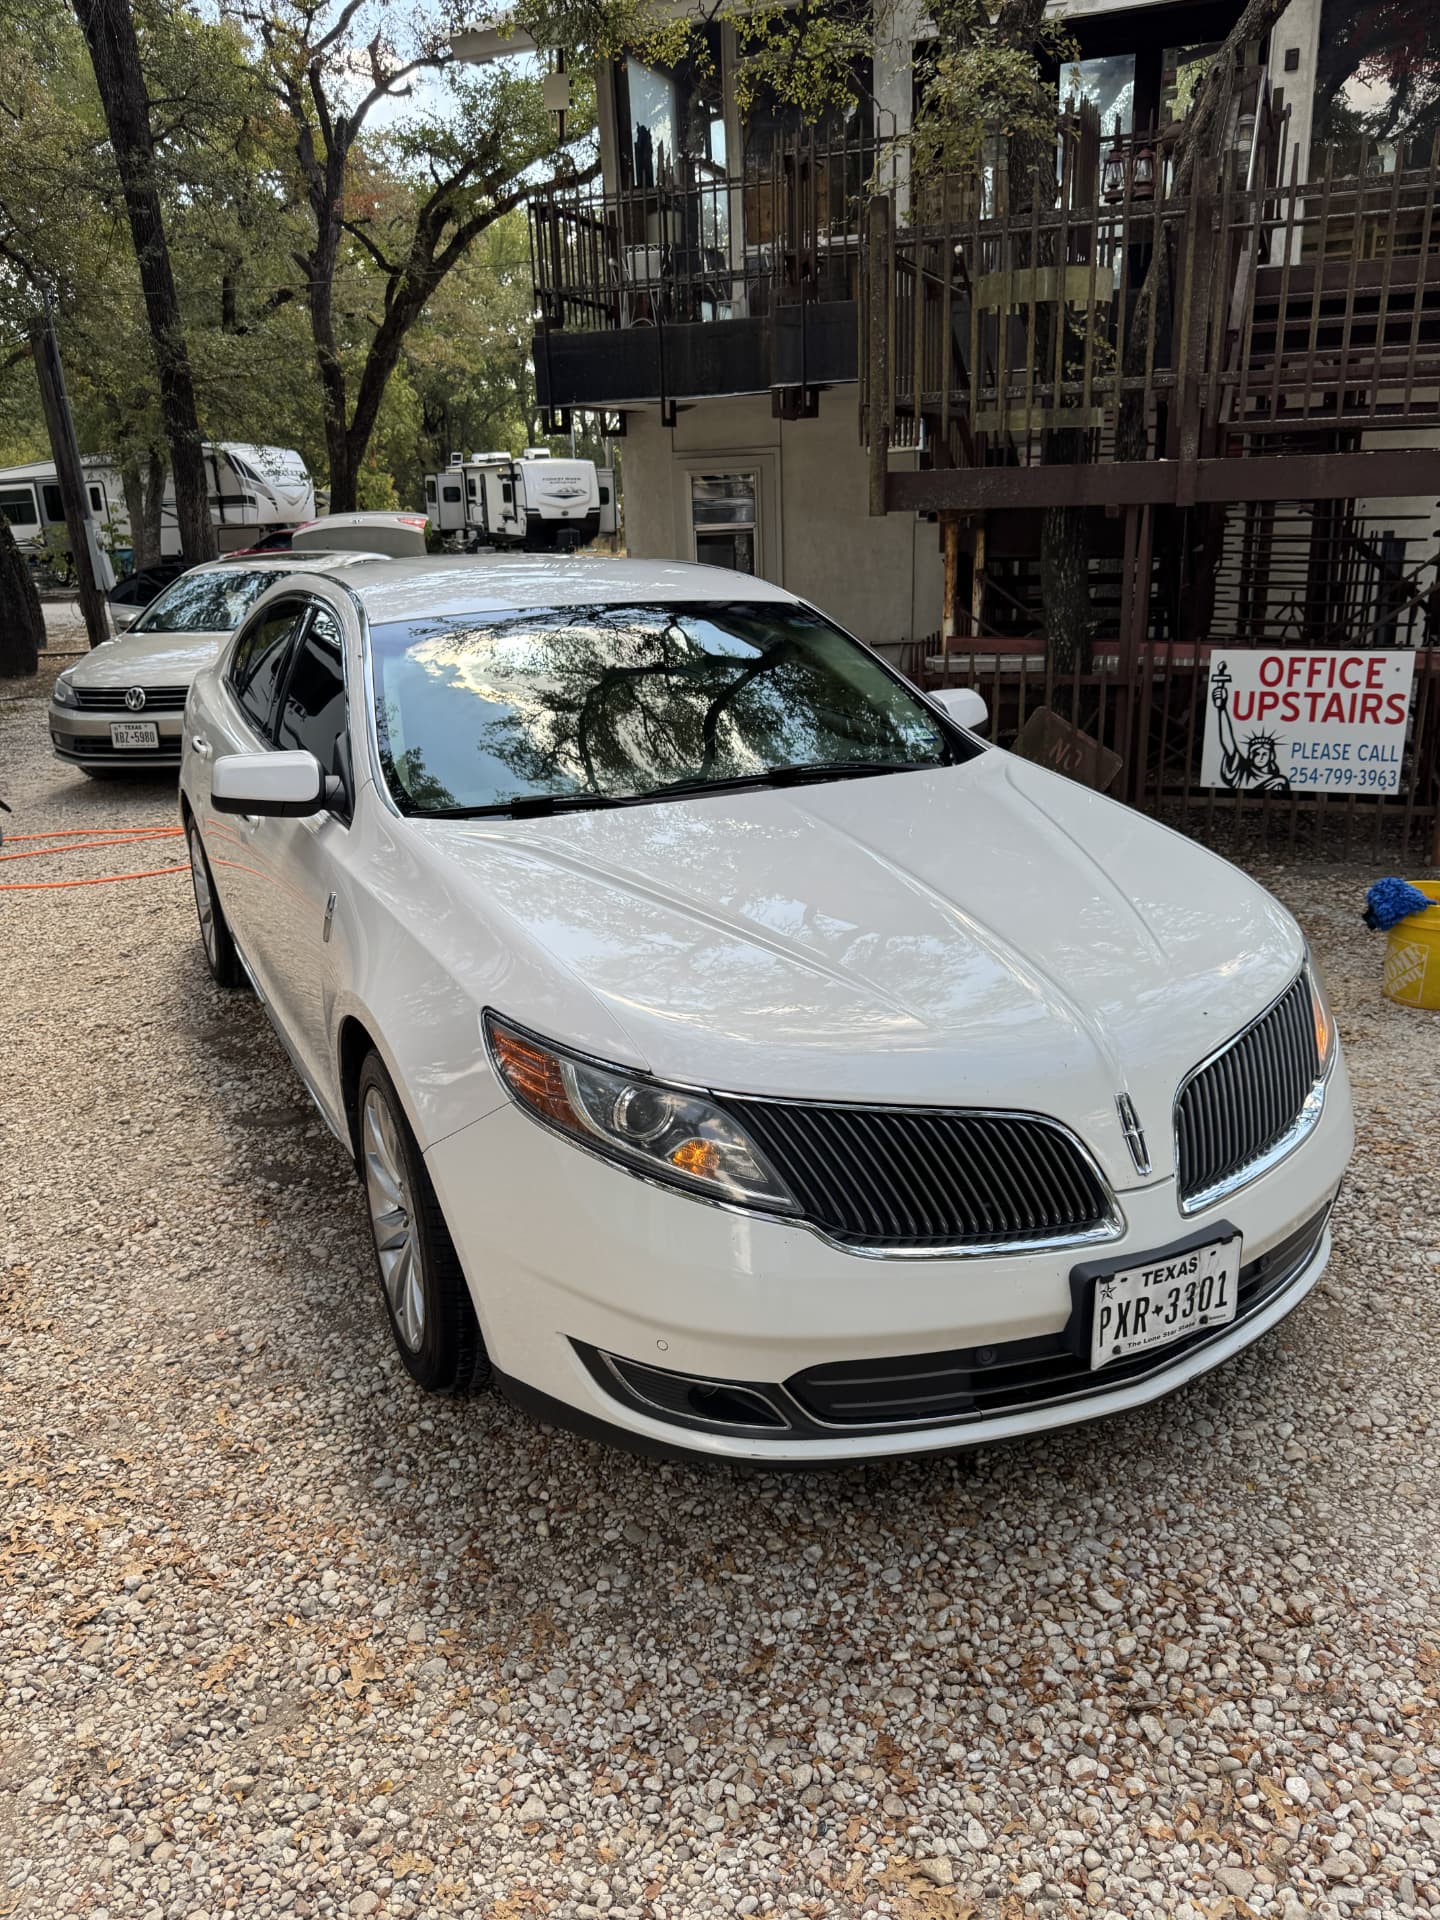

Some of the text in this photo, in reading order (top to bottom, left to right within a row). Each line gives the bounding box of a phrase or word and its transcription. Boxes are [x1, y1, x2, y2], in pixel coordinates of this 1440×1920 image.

[1259, 656, 1387, 689] OFFICE
[1232, 690, 1406, 725] UPSTAIRS
[1291, 742, 1399, 762] PLEASE CALL
[1288, 767, 1397, 787] 254-799-3963
[1142, 1256, 1199, 1288] TEXAS
[1127, 1341, 1142, 1349] The
[1143, 1335, 1161, 1344] Lone
[1162, 1329, 1177, 1338] Star
